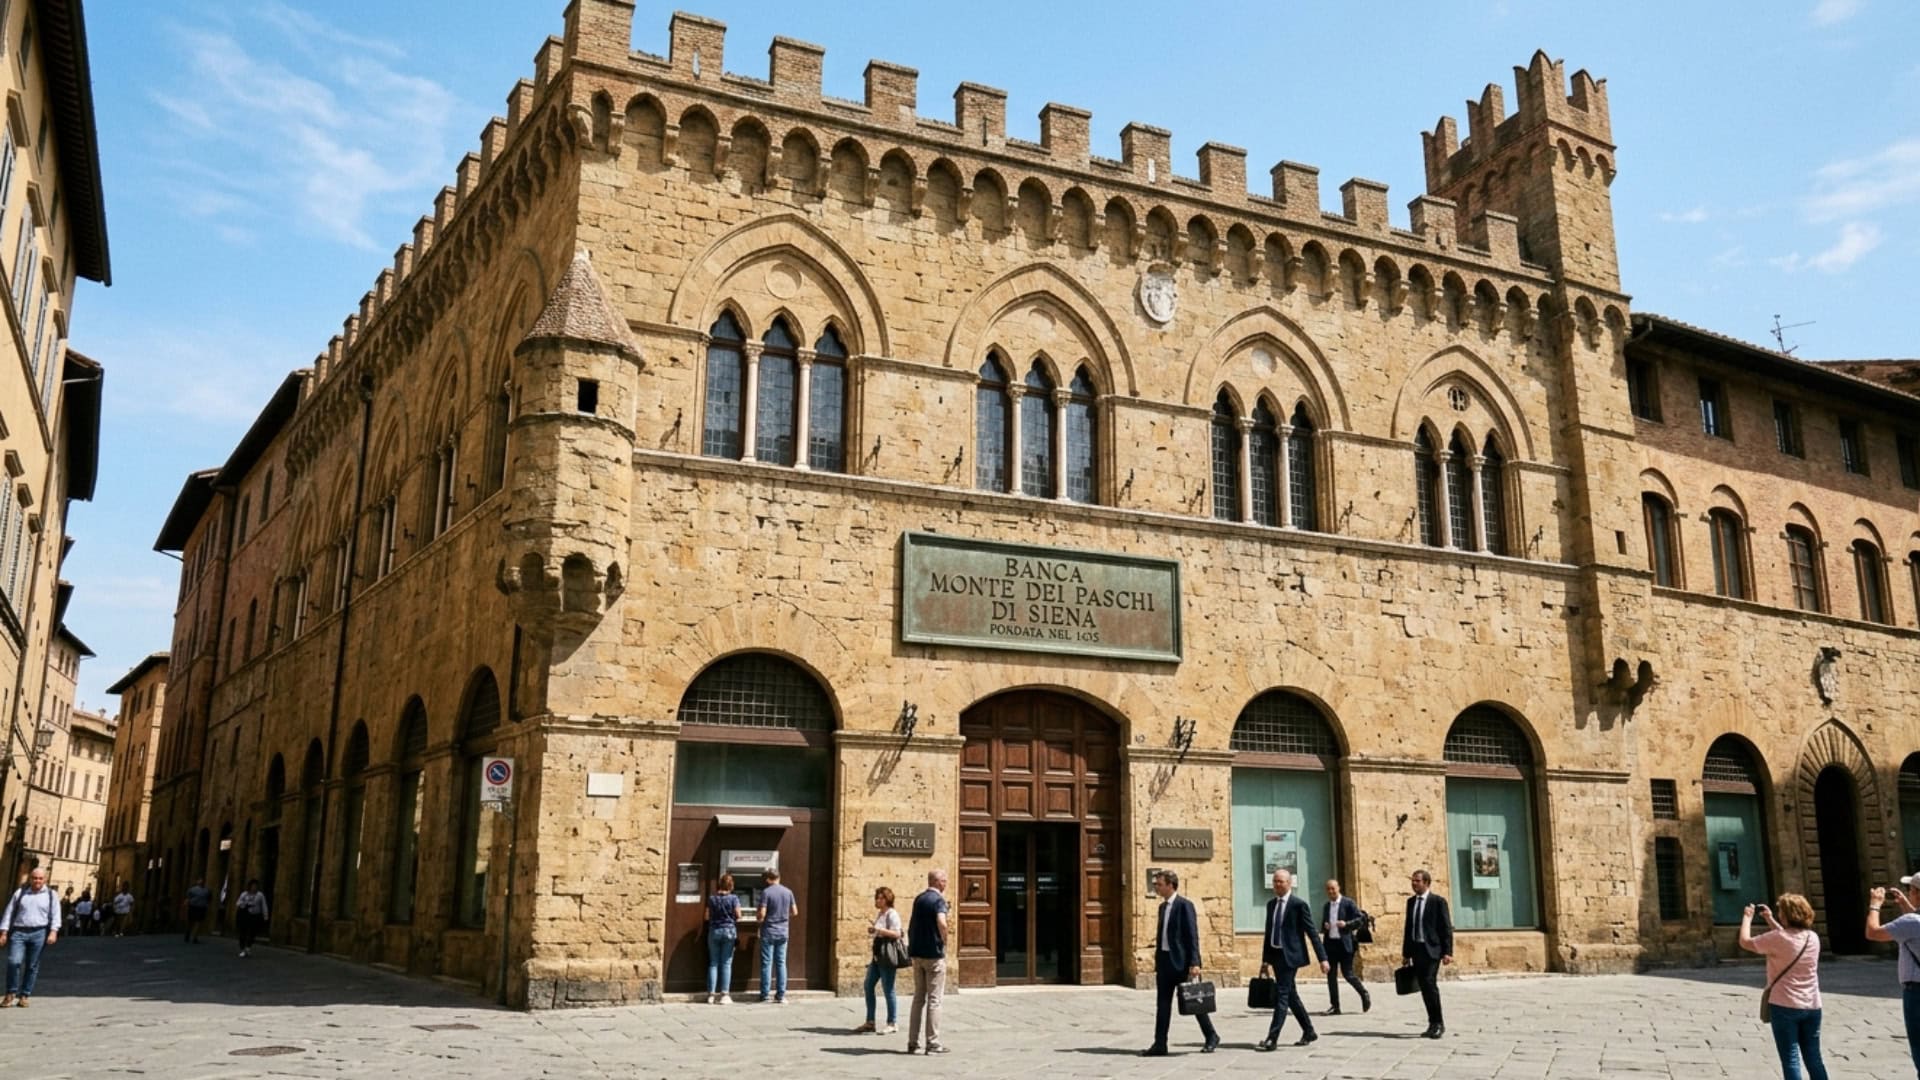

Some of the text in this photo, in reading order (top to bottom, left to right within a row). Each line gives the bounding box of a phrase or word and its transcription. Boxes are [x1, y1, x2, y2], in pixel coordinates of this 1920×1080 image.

[1005, 558, 1083, 583] BANCA
[930, 572, 1155, 612] MONTE DEI PASCHI
[991, 601, 1096, 628] DI SIENA
[1048, 628, 1072, 640] NEL
